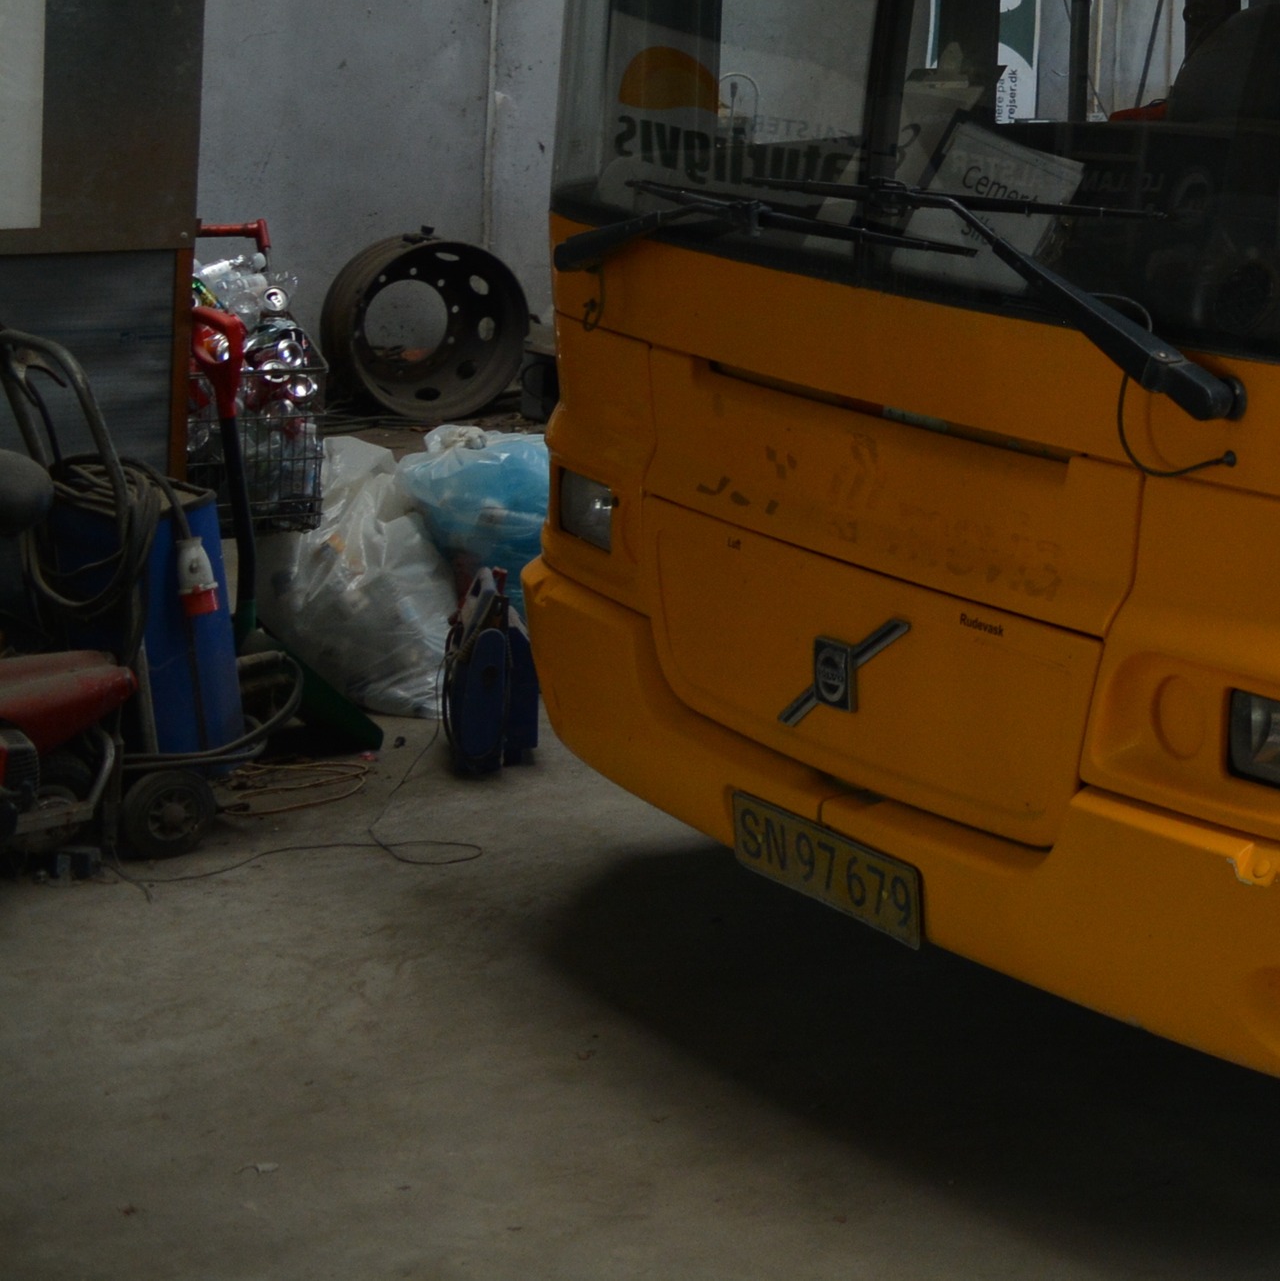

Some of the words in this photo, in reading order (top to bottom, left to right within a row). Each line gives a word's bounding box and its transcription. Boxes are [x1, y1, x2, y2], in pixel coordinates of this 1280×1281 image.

[740, 808, 788, 871] SN
[795, 831, 836, 891] 97
[846, 856, 913, 927] 679
